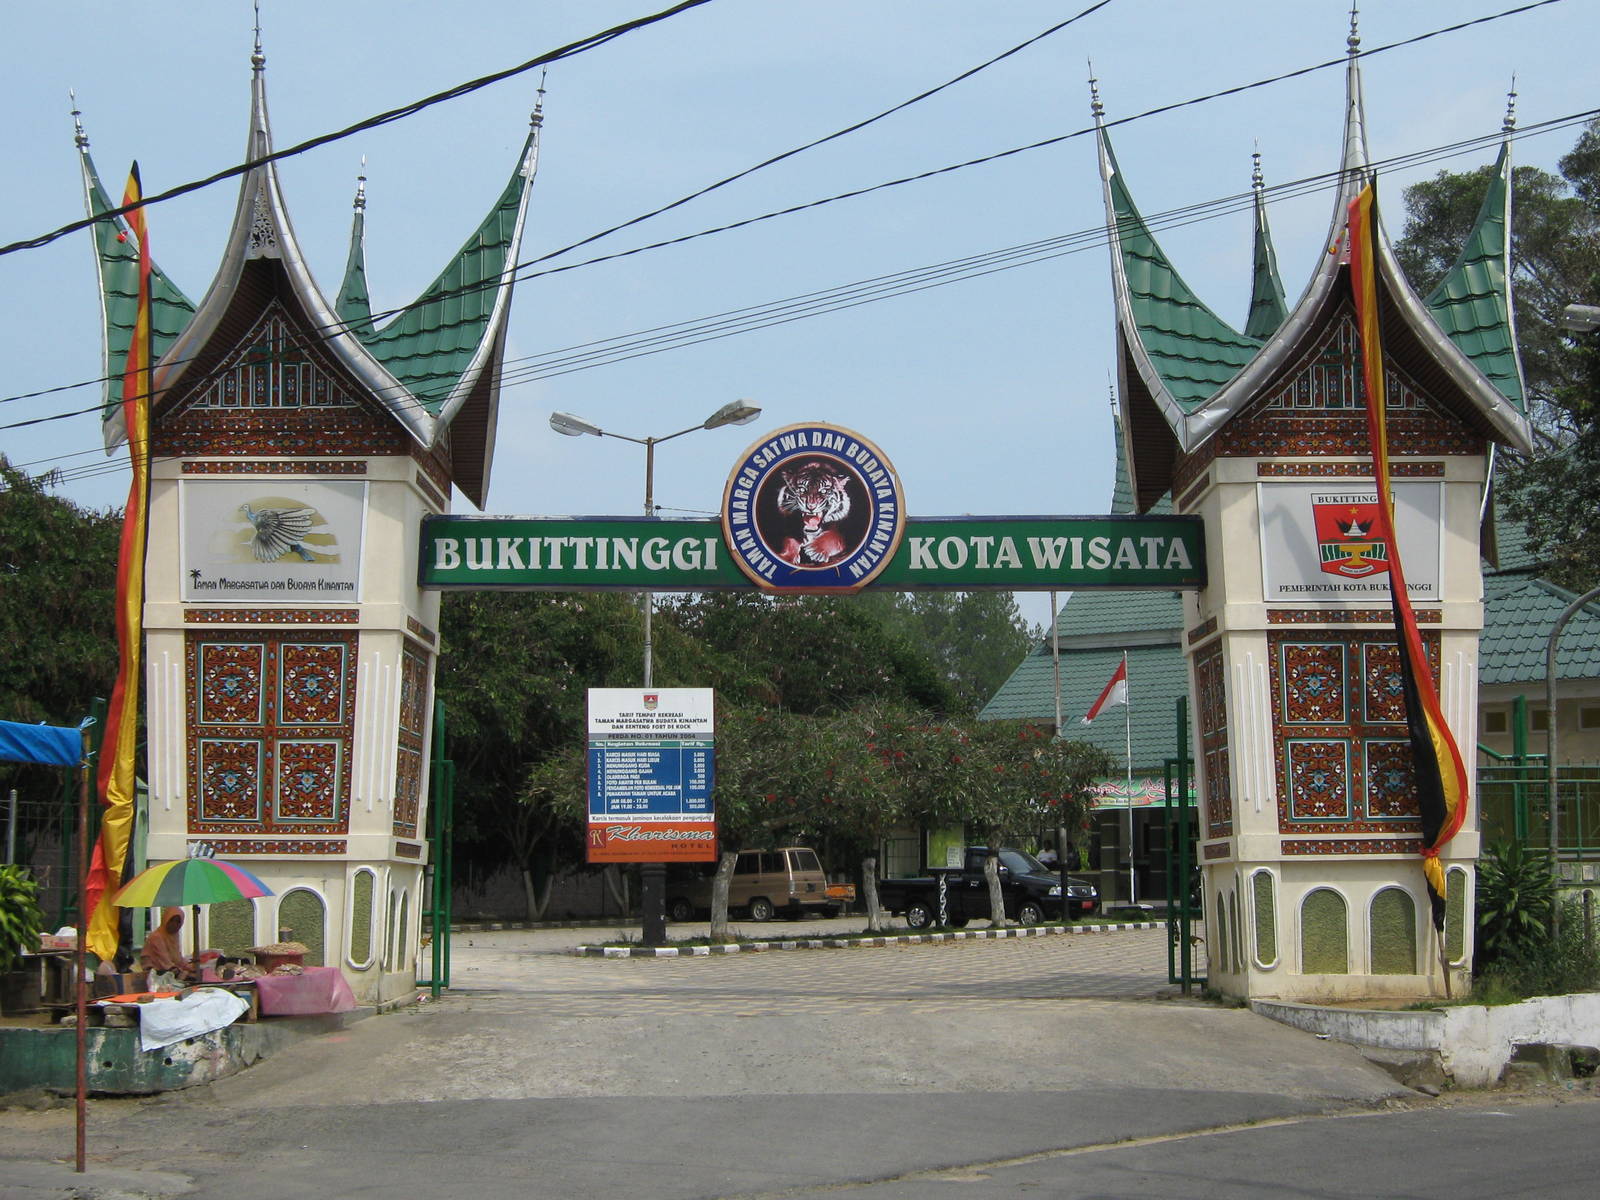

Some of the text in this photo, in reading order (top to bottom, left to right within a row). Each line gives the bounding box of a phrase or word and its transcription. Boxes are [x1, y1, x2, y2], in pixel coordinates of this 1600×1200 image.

[732, 432, 894, 579] TAMAN MARGA SATWA DAN BUDAYA KINANTAN
[434, 536, 718, 570] BUKITTINGGI
[908, 536, 1192, 570] KOTA WISATA
[219, 578, 269, 590] MARGASATWA
[288, 578, 316, 590] BUDAYA
[318, 578, 354, 590] KINANTAN
[1280, 584, 1340, 592] PEMERINTAH
[1344, 584, 1368, 592] KOTA
[606, 825, 714, 841] Kharisma
